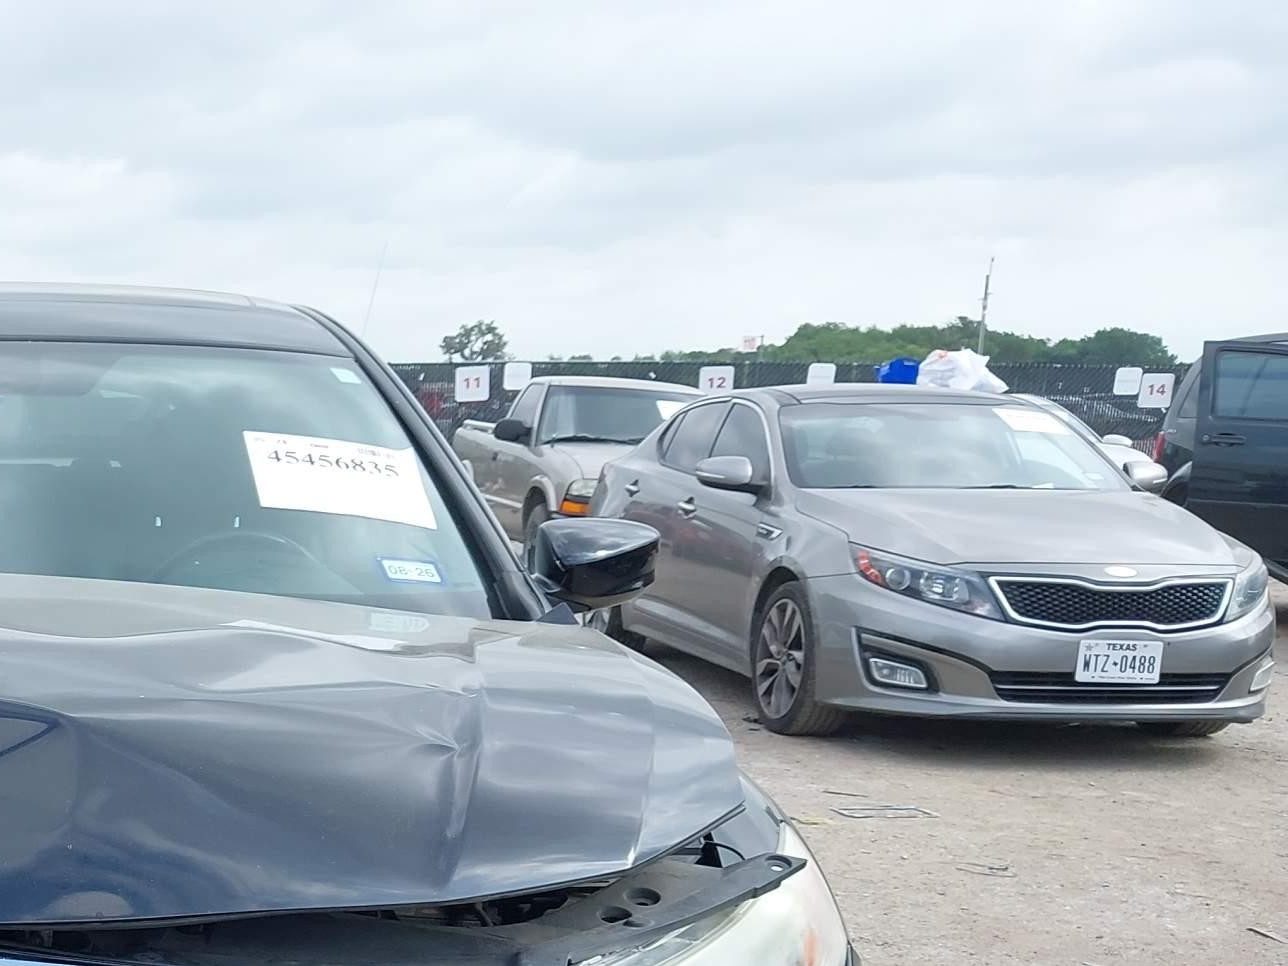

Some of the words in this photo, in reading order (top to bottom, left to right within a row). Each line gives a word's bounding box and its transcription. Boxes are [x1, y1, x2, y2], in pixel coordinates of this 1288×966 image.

[463, 376, 481, 389] 11
[708, 376, 727, 389] 12
[1148, 383, 1167, 396] 14
[266, 449, 400, 477] 45456835
[1106, 642, 1138, 651] TEXAS
